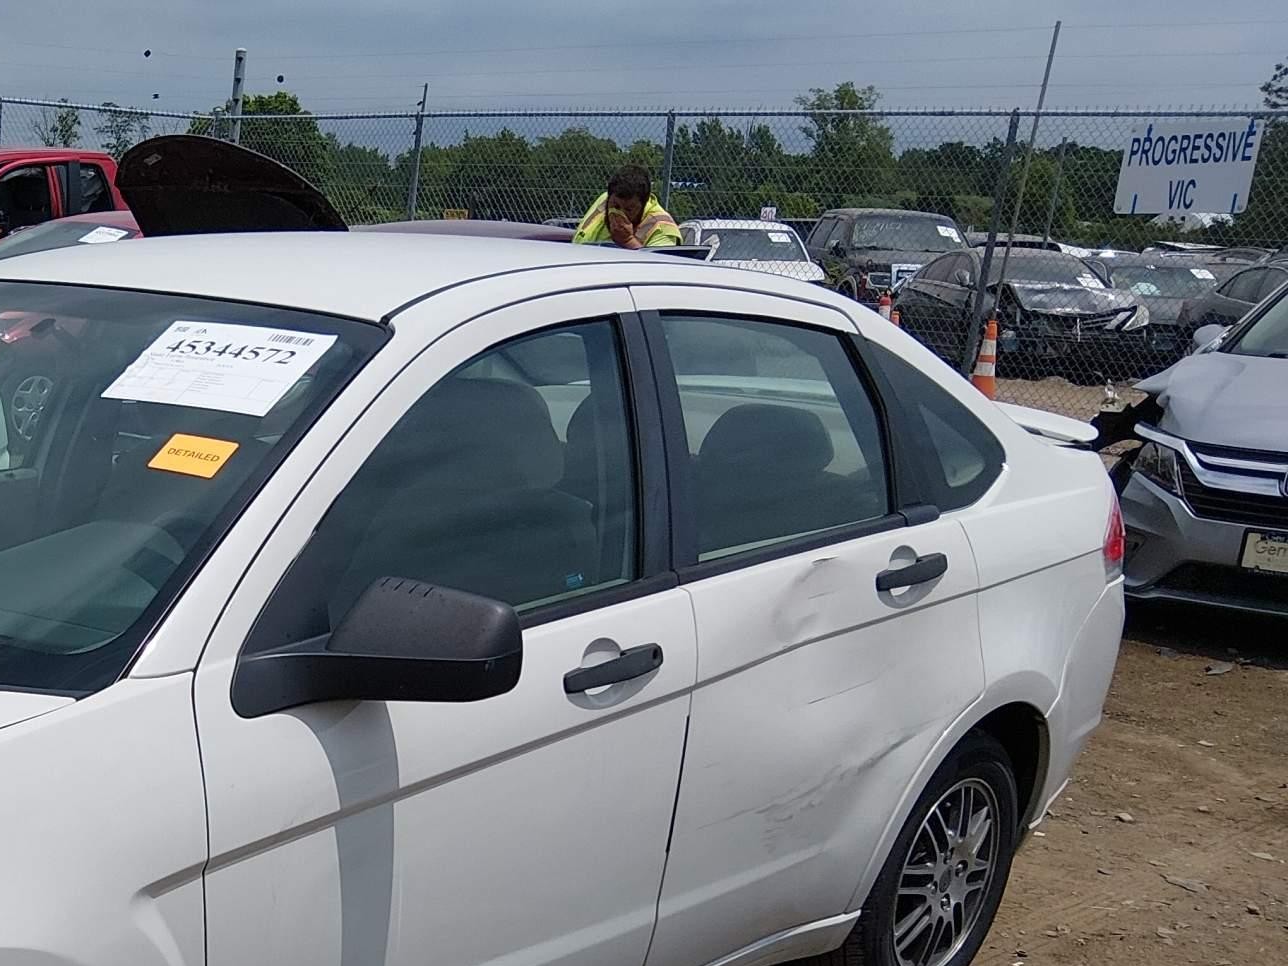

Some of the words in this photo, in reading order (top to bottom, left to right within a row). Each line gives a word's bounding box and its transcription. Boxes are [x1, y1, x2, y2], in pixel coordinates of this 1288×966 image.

[1128, 130, 1257, 166] PROGRESSIVE
[1168, 179, 1197, 210] VIC
[165, 338, 297, 365] 45344572
[167, 447, 221, 462] DETAILED
